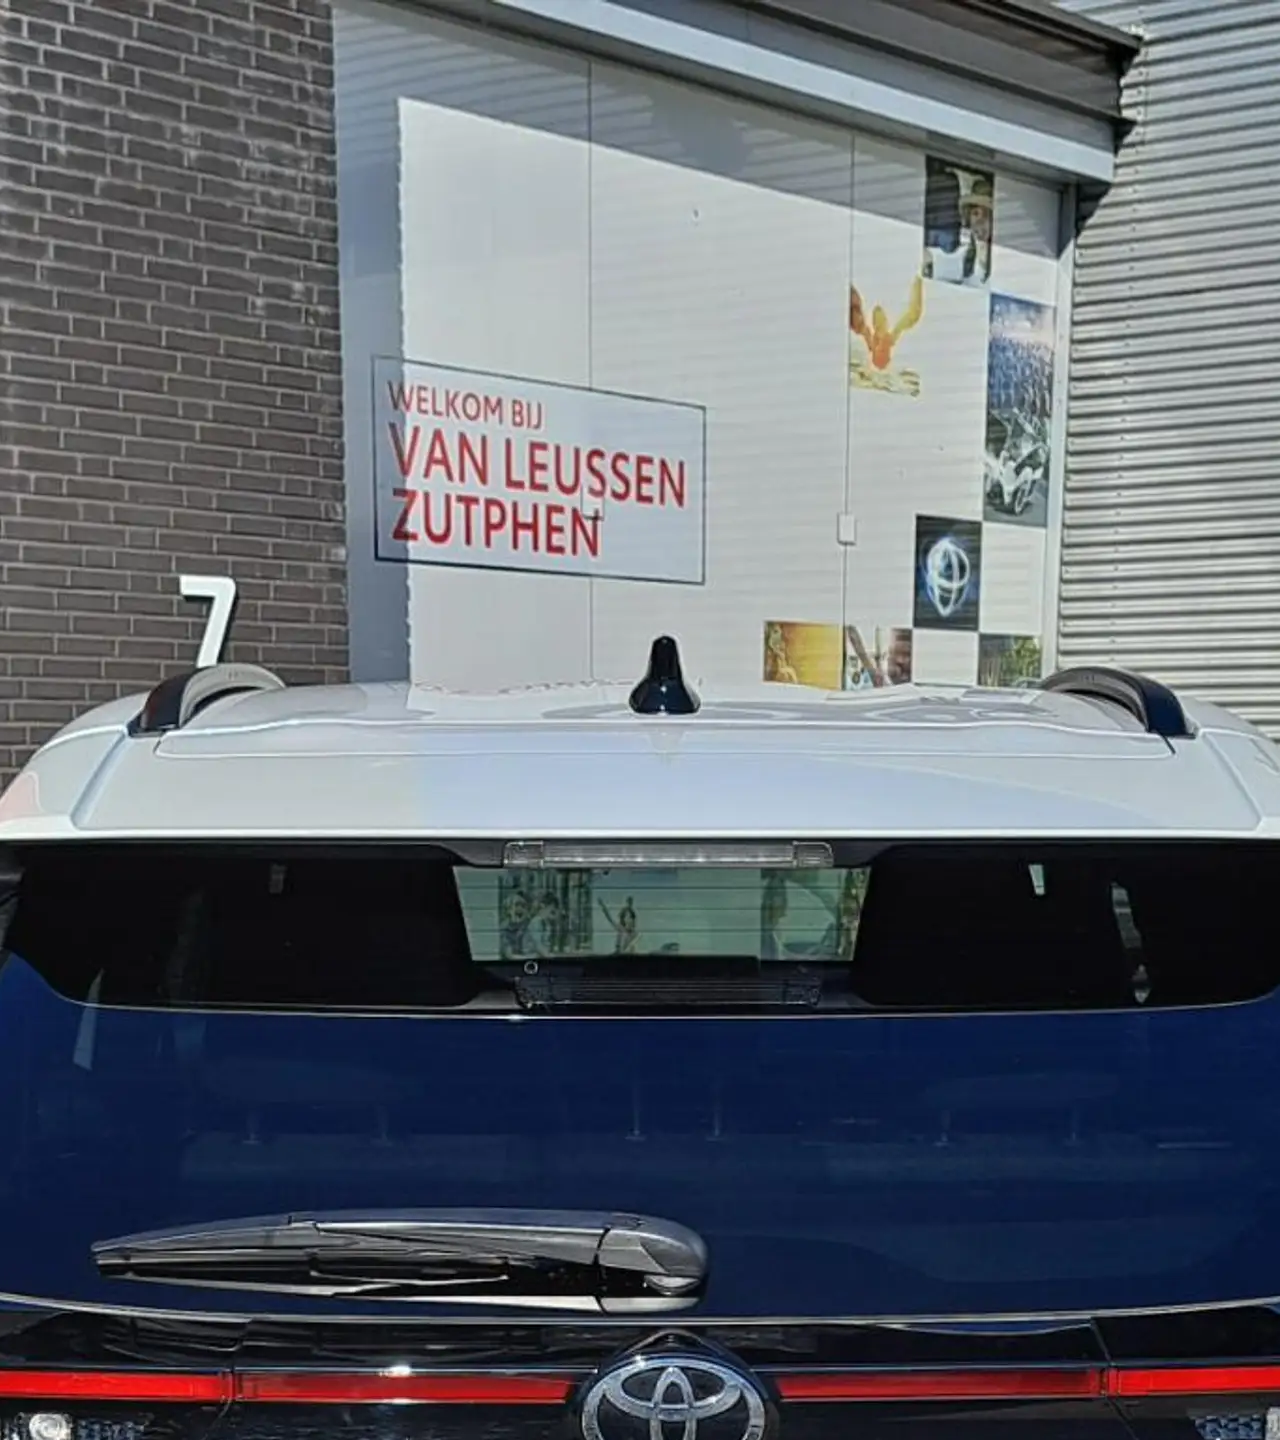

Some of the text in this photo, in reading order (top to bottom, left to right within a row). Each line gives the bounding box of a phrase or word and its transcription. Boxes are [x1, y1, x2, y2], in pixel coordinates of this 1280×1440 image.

[387, 380, 544, 430] WELKOM BIJ
[388, 421, 686, 508] VAN LEUSSEN
[392, 487, 600, 557] ZUTPHEN
[180, 575, 236, 668] 7
